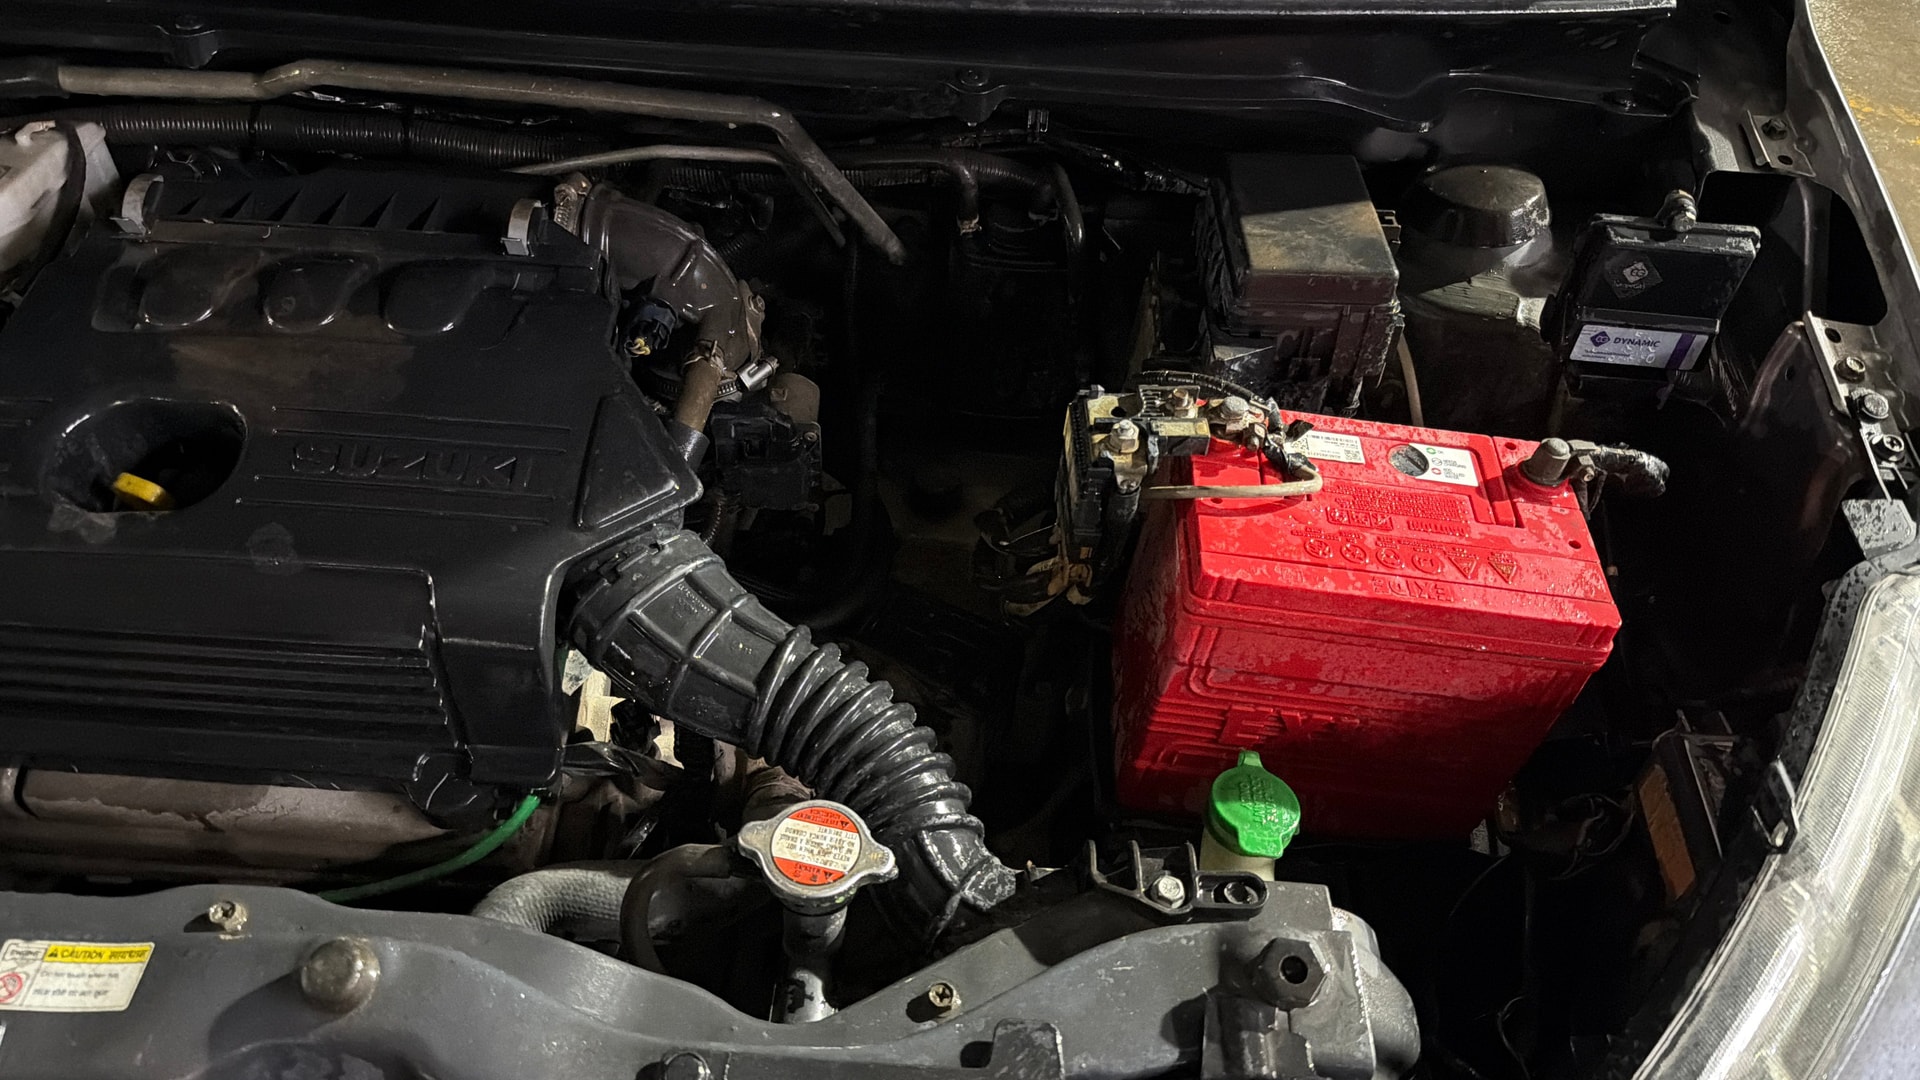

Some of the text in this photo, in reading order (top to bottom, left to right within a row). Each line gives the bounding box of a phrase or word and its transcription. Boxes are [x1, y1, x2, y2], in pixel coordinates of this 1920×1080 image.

[1613, 337, 1660, 347] DYNAMIC
[291, 444, 534, 488] SUZUKI
[1372, 576, 1455, 602] EXIDE
[784, 826, 807, 836] CUANDO
[808, 831, 827, 841] NUNCA
[61, 950, 102, 959] CAUTION
